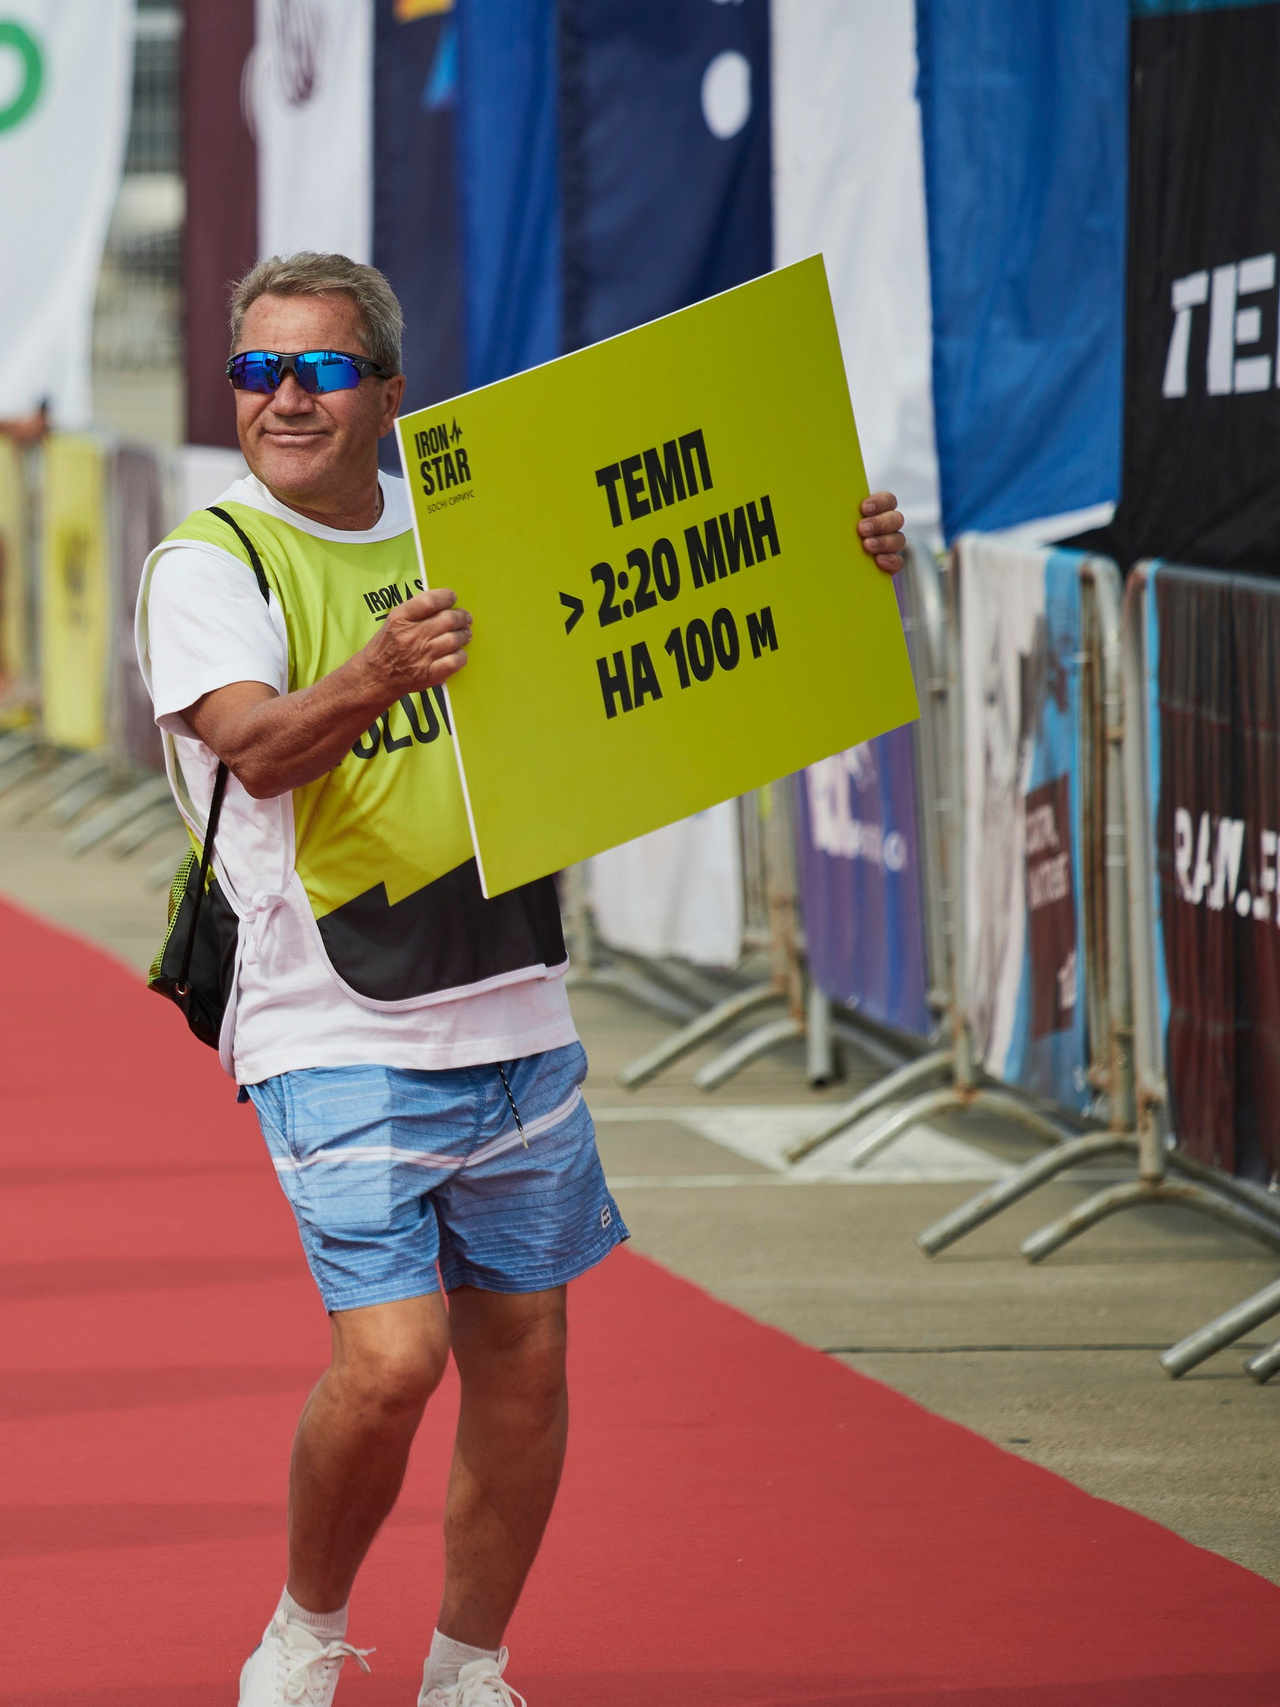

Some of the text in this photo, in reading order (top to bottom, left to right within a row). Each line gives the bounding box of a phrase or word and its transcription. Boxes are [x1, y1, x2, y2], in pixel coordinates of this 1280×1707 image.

[1161, 252, 1280, 399] TE
[414, 423, 450, 460] IRON
[420, 448, 472, 496] STAR
[595, 428, 713, 528] ТЕМП
[363, 583, 403, 614] IRON
[590, 537, 681, 628] 2:20
[683, 494, 782, 590] МИН
[596, 641, 663, 720] НА
[664, 607, 740, 690] 100
